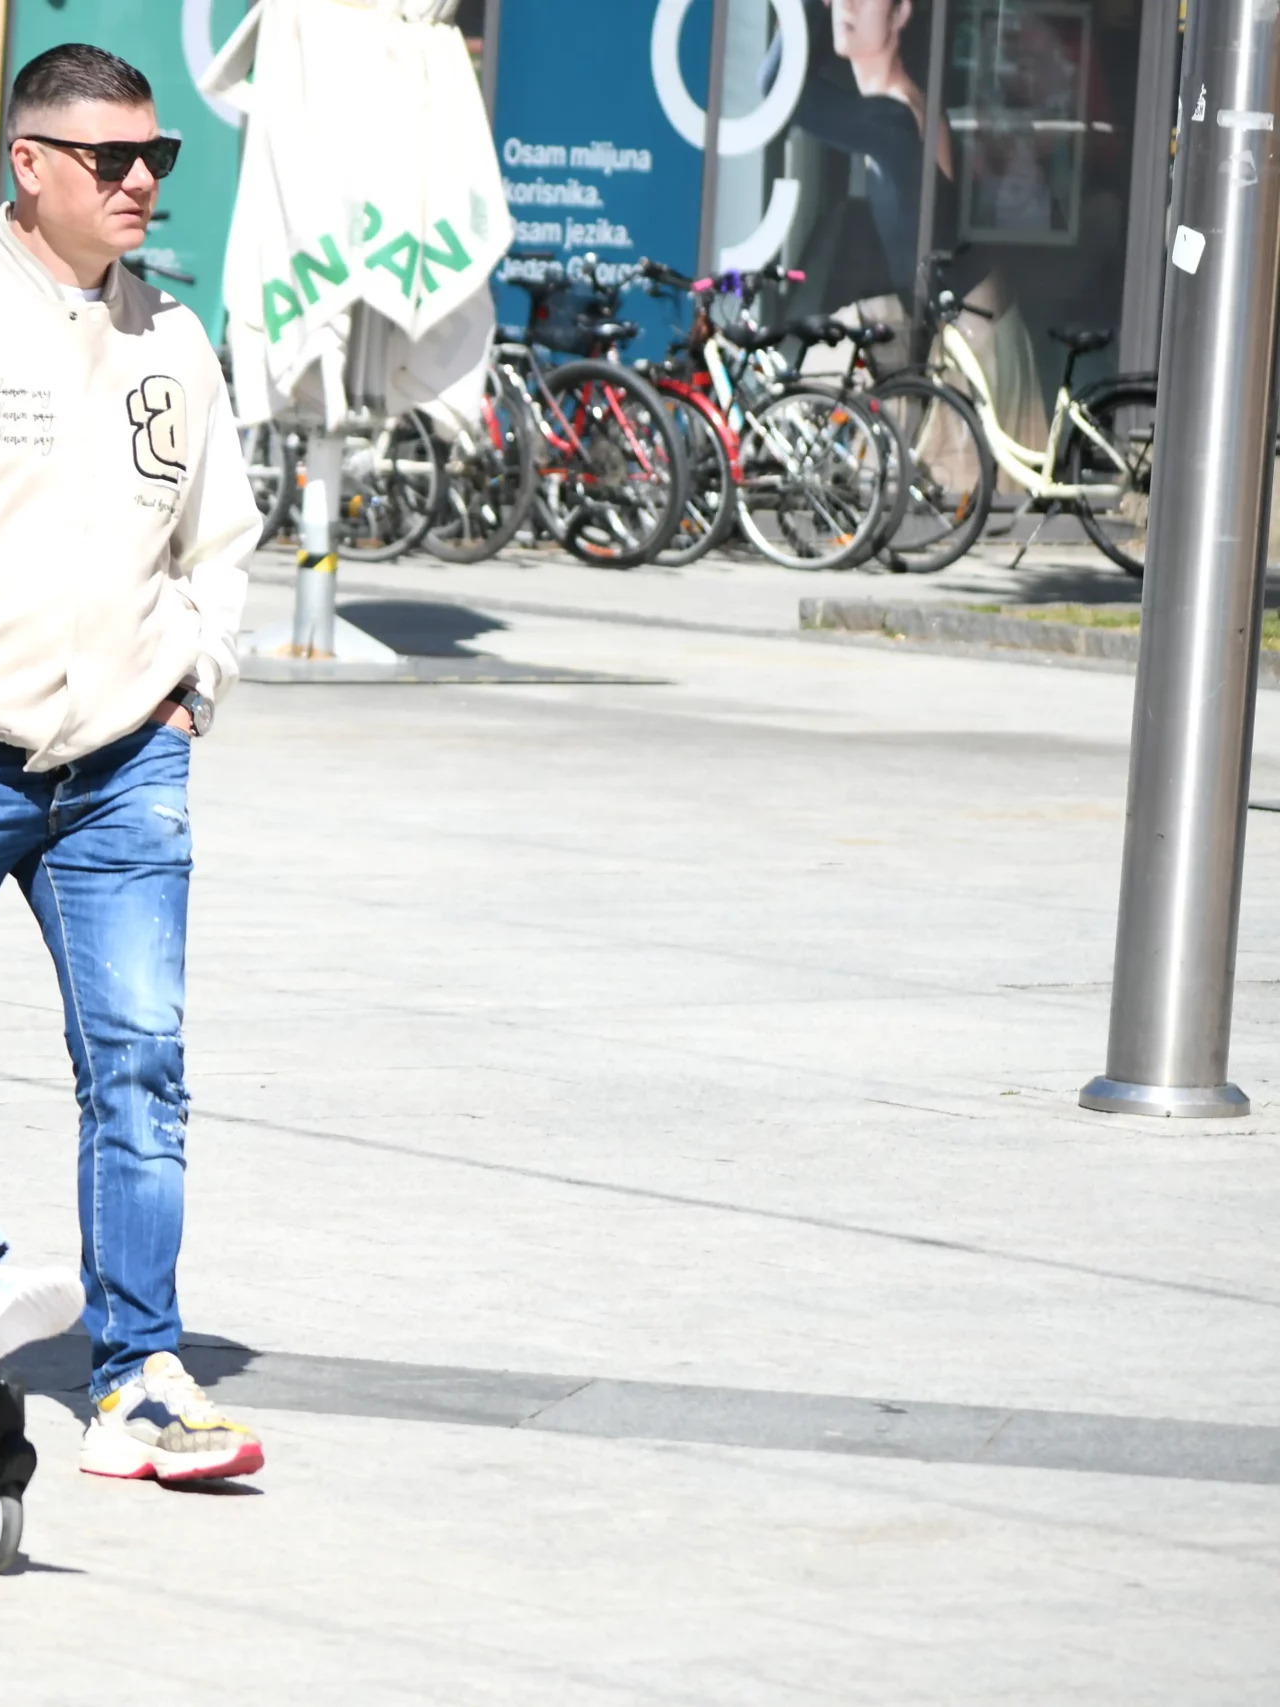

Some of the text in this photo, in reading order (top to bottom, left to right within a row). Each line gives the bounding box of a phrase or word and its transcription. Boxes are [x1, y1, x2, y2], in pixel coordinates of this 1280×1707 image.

[503, 137, 652, 177] Osam milijuna
[510, 215, 634, 251] sam jezika.
